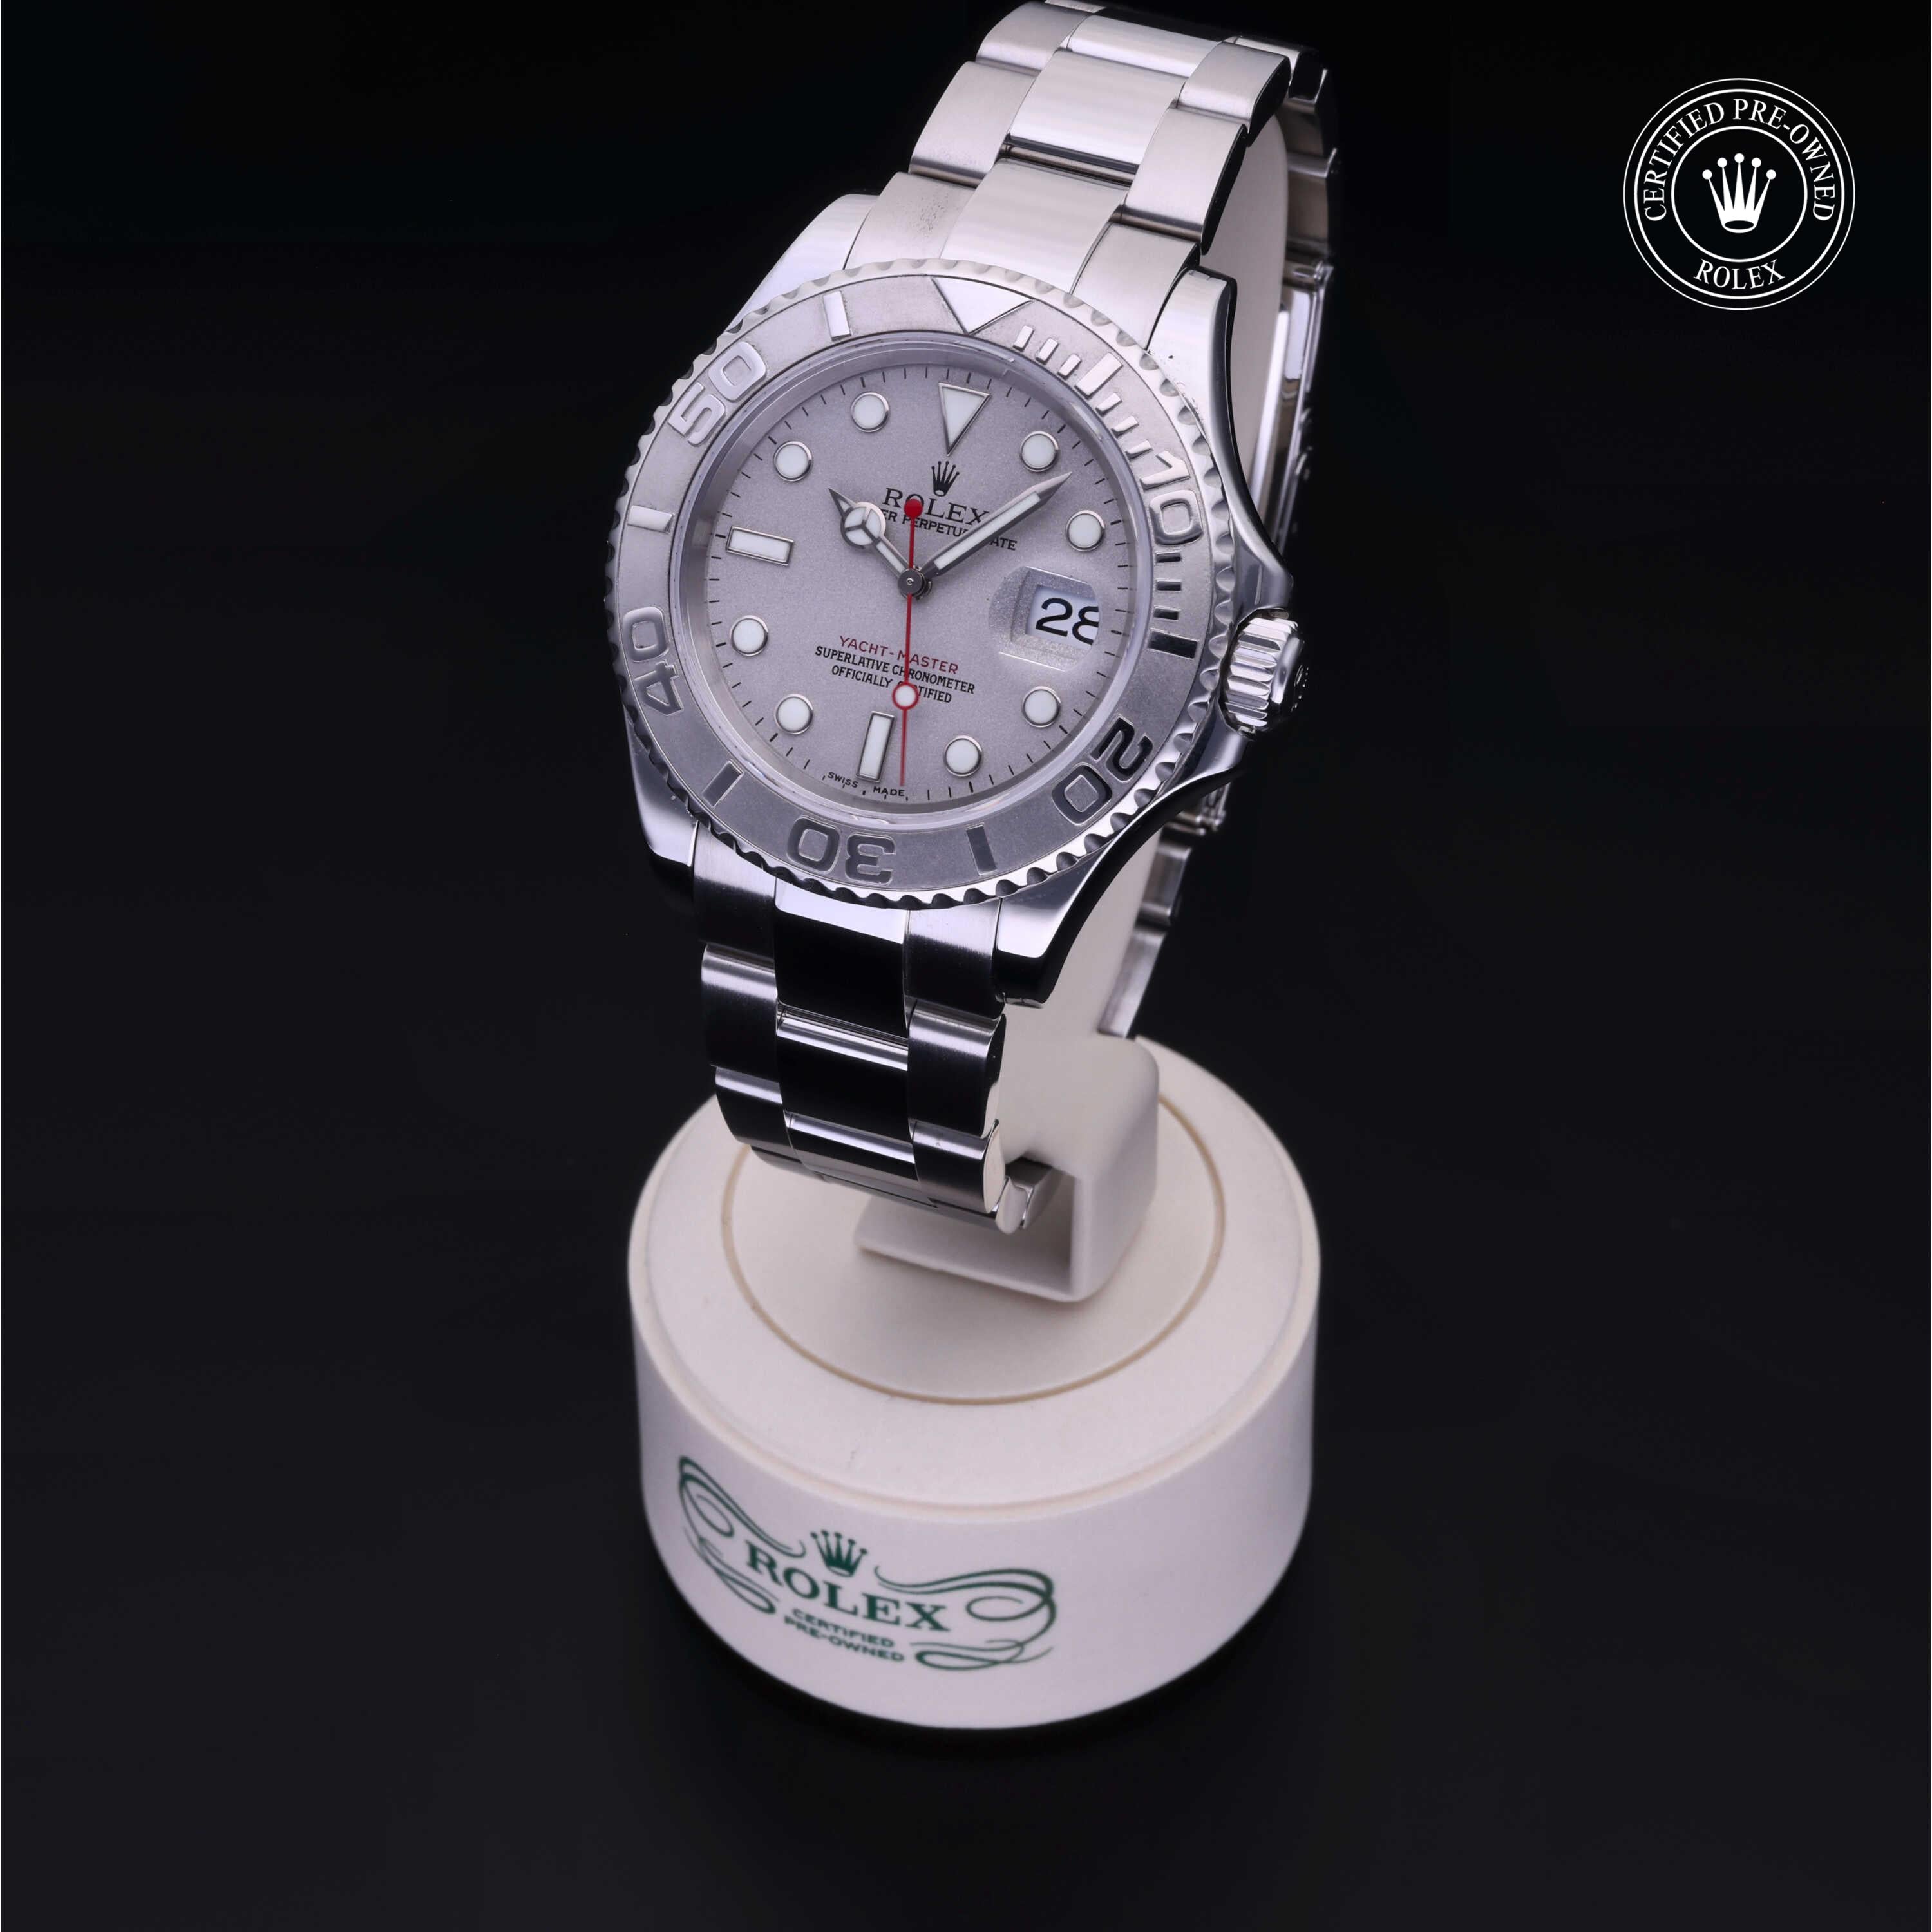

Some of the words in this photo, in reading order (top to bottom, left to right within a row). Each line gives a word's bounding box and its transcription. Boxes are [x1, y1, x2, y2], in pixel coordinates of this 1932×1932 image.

[667, 341, 767, 446] 50
[1139, 450, 1204, 545] 10
[902, 514, 968, 537] PERPETU
[989, 537, 1018, 551] ATE
[1035, 597, 1099, 645] 28
[622, 606, 684, 716] 40
[815, 645, 890, 673] SUPERLATIVE
[892, 664, 975, 694] CHRONOMETER
[839, 635, 958, 674] YACHT-MASTER
[831, 665, 893, 688] OFFICIALLY
[896, 681, 952, 703] TIFIED
[828, 772, 858, 788] SWISS
[873, 786, 905, 797] MADE
[1052, 715, 1153, 825] 20
[786, 815, 896, 886] 30
[745, 1539, 951, 1632] ROLEX
[784, 1615, 905, 1662] PRE-OWNED
[793, 1608, 895, 1647] CERTIFIED
